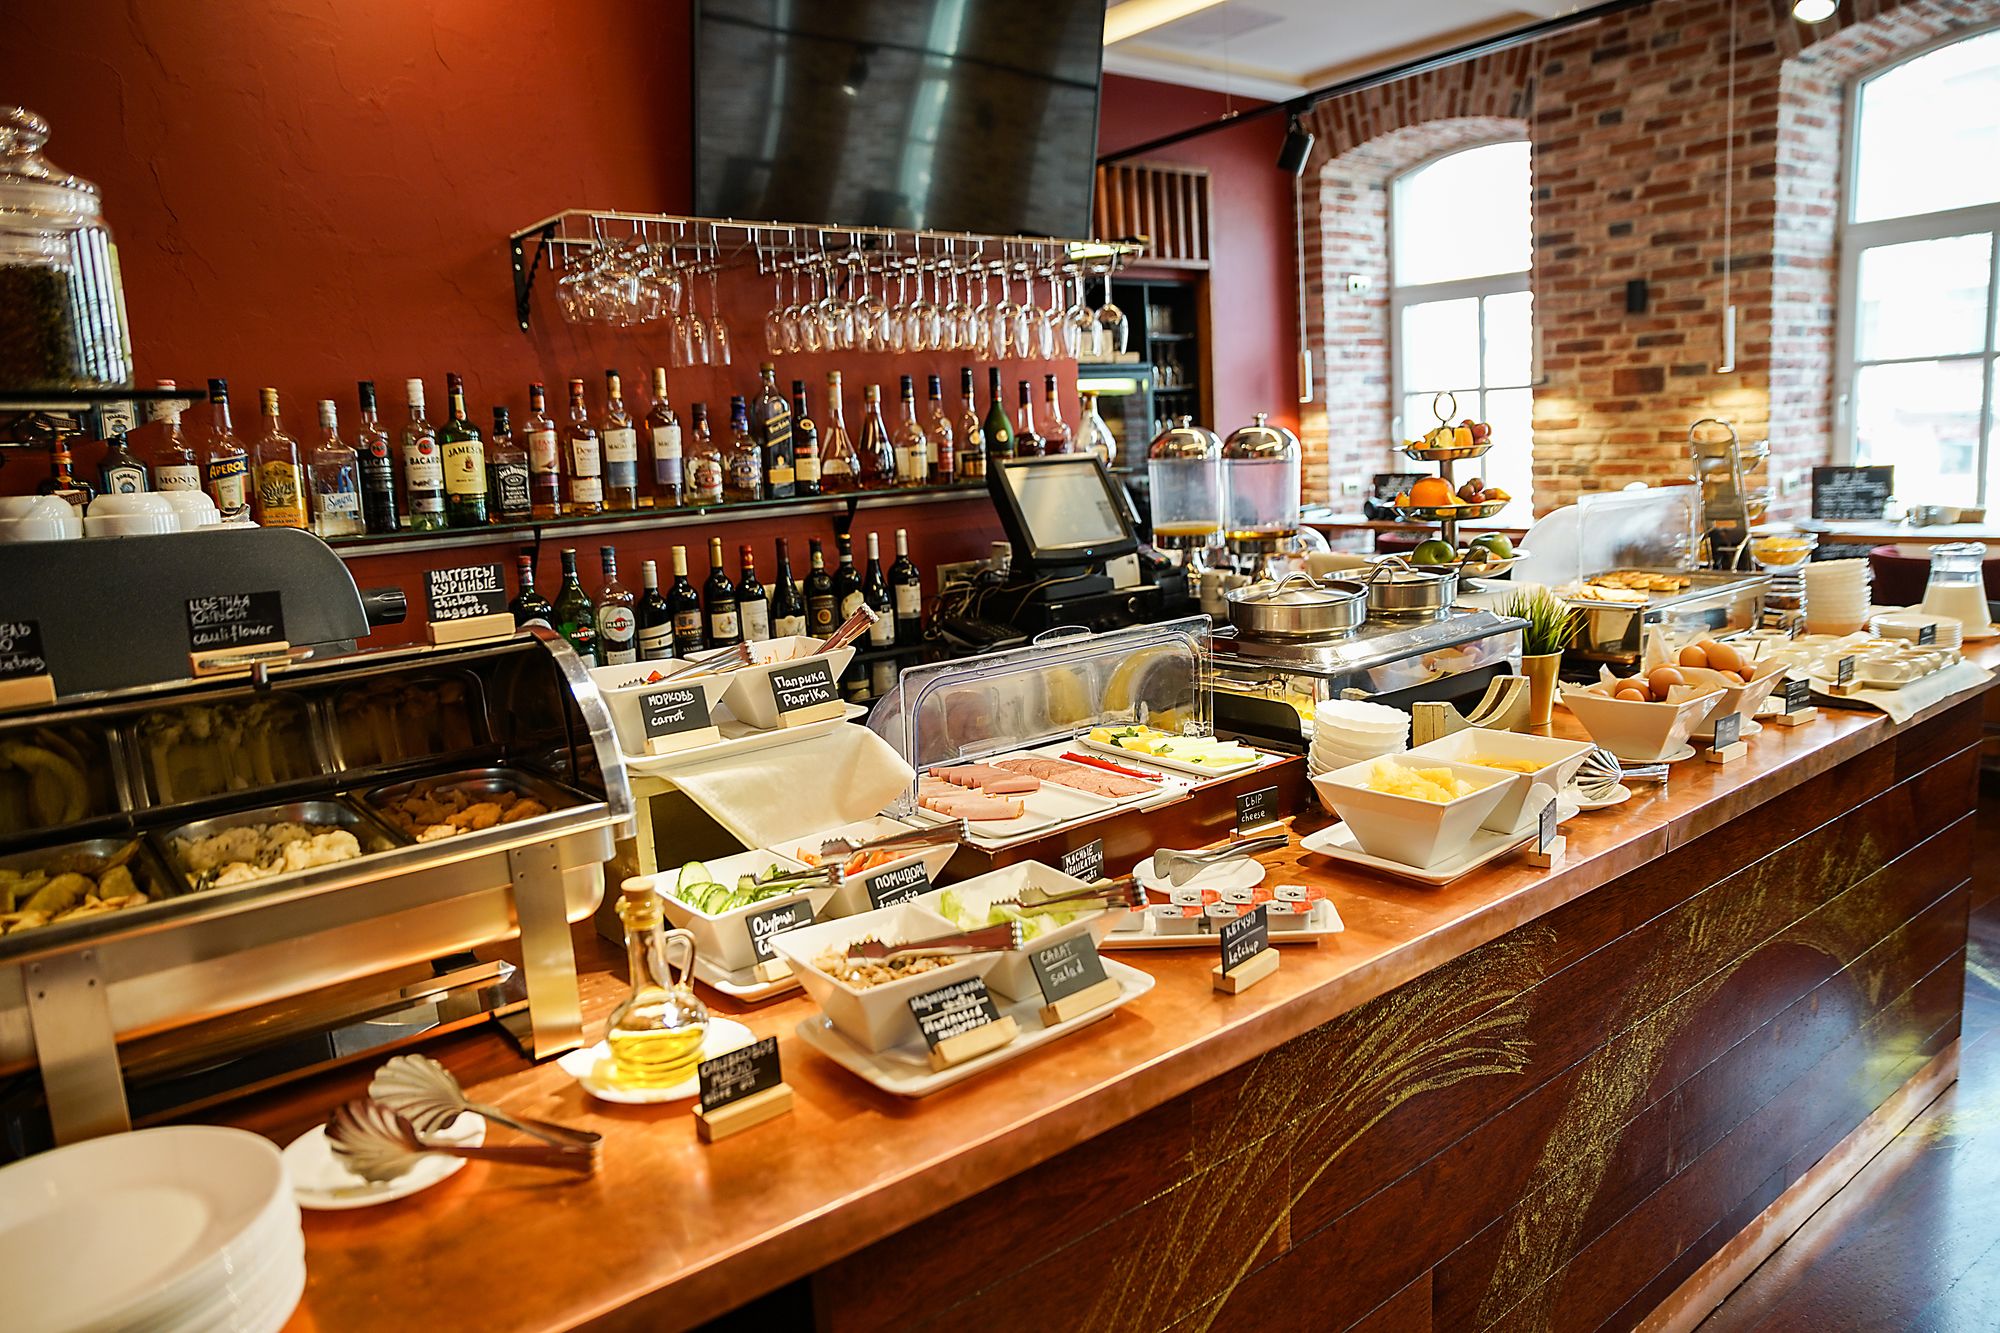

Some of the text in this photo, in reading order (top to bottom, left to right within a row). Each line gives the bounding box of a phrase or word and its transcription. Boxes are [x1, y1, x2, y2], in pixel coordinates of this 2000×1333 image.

[209, 460, 247, 478] APEROL
[160, 475, 198, 487] MONIN
[431, 565, 495, 584] НАГГЕТСЫ
[431, 577, 497, 597] КУРИНЫЕ
[189, 595, 250, 612] ЦВЕТНАЯ
[606, 620, 633, 629] MARTINI
[193, 624, 274, 645] cauliflower
[773, 671, 826, 689] Паприка
[648, 690, 694, 706] МОРКОВЬ
[651, 709, 685, 726] carrot
[1245, 793, 1263, 807] СЫР
[1241, 810, 1266, 823] cheese
[1225, 911, 1256, 939] КЕТЧУП
[1040, 941, 1072, 965] САЛАТ
[1228, 941, 1259, 965] ketchup
